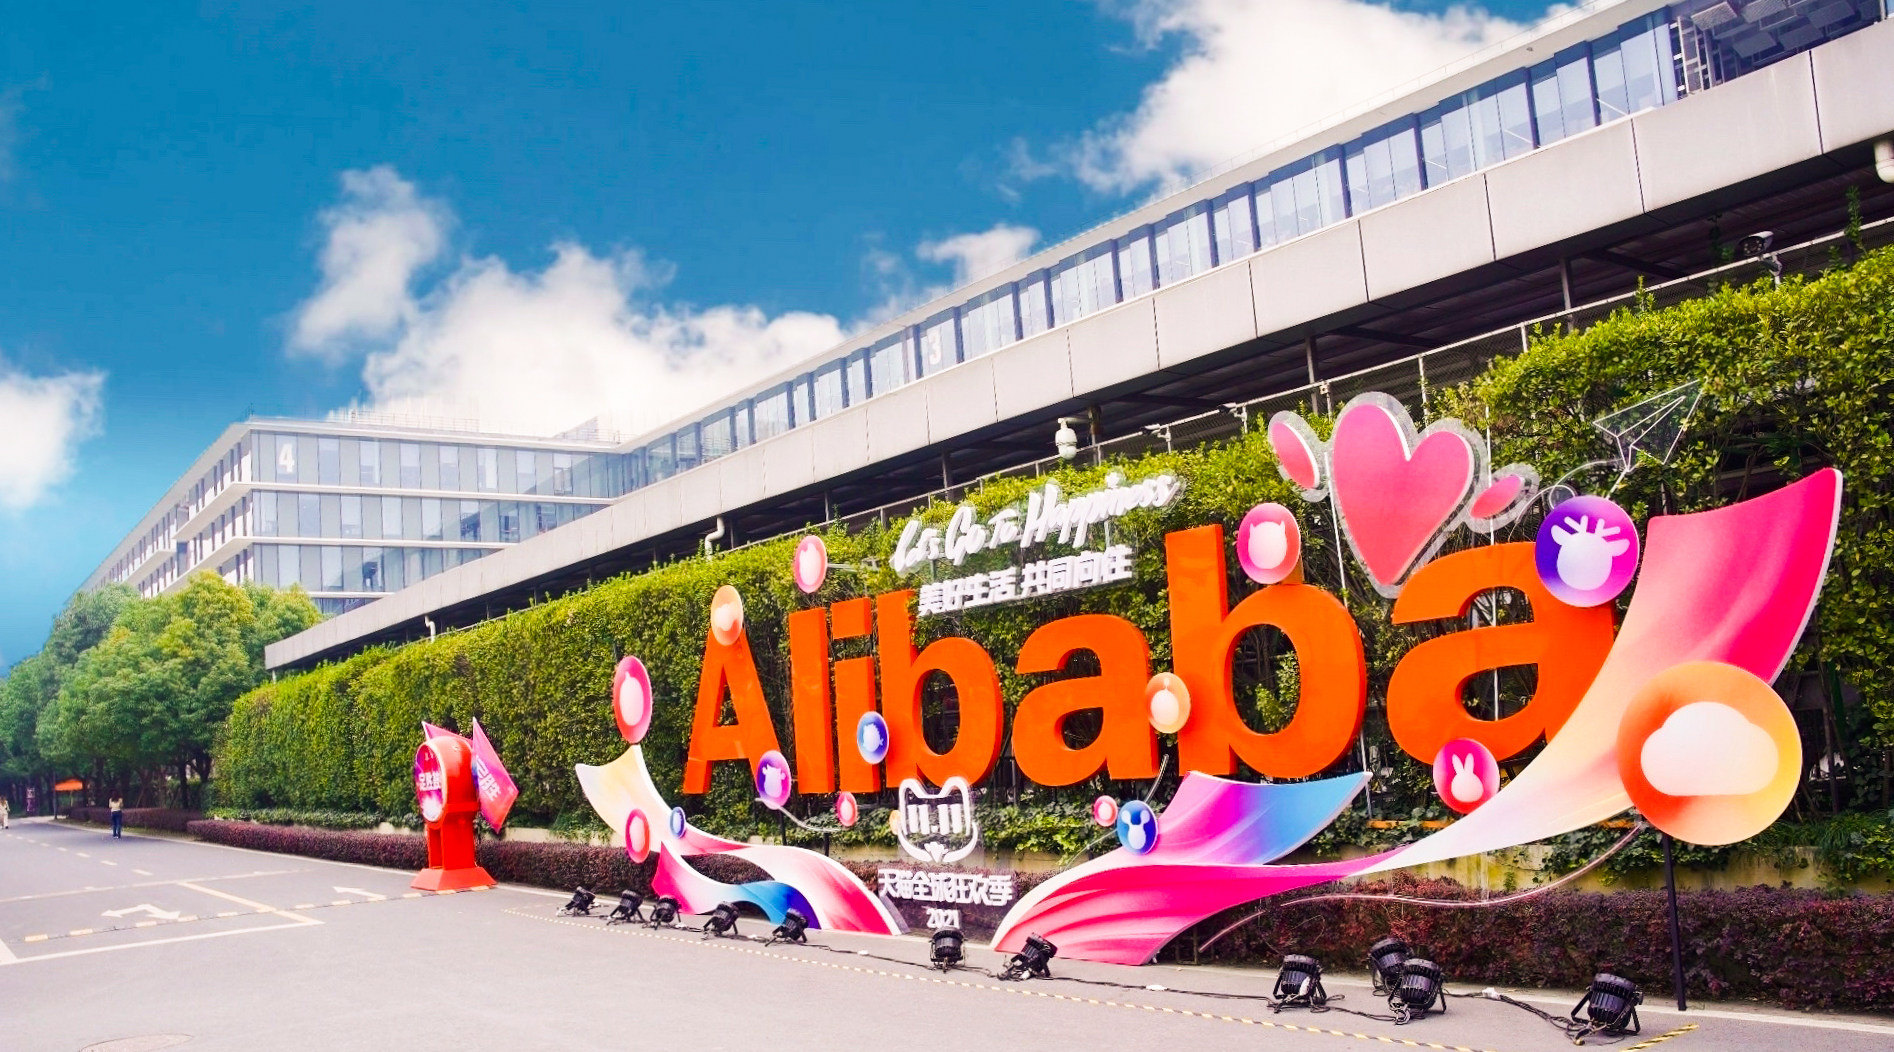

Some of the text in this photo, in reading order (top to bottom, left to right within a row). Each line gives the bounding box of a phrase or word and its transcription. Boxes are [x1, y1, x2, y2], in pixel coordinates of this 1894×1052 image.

[928, 331, 942, 364] 3
[278, 443, 295, 474] 4
[945, 506, 985, 565] Go
[1021, 472, 1180, 548] Happiness
[918, 544, 1132, 616] 美好生活 共同向往
[683, 523, 1616, 796] Alibaba
[907, 803, 963, 836] 11.11
[878, 869, 1012, 906] 天猫全球狂欢季
[926, 908, 961, 929] 2021
